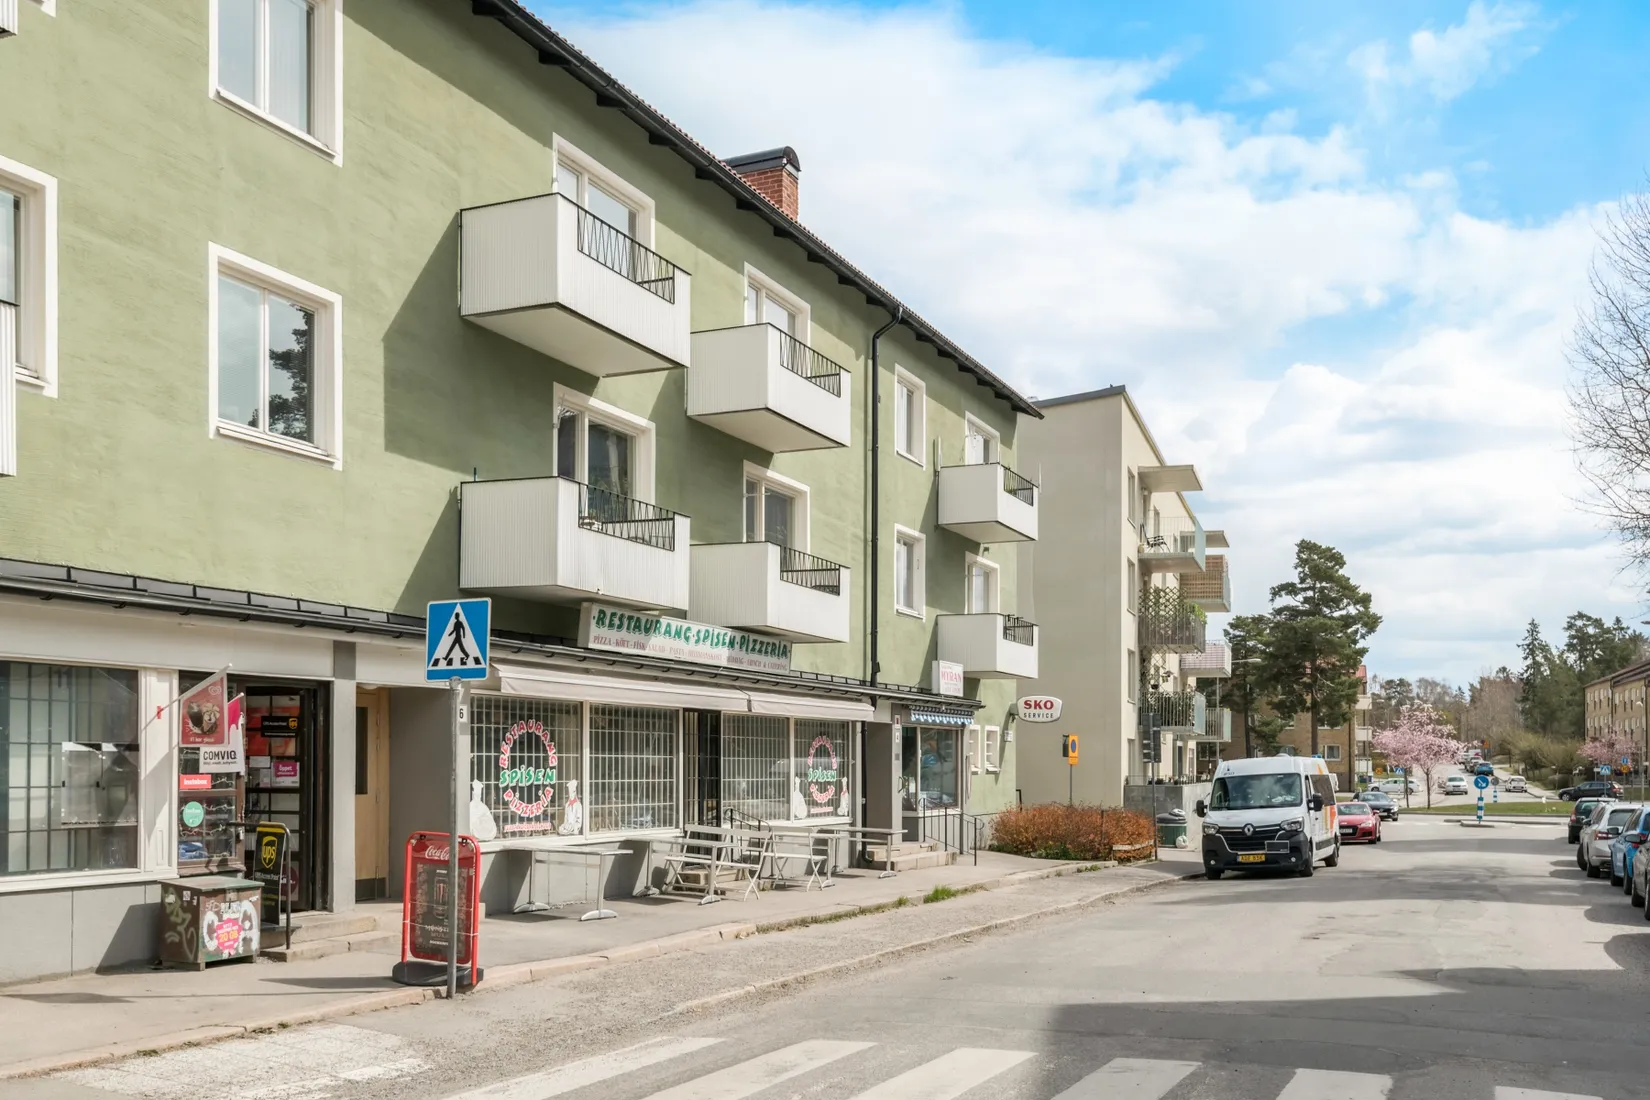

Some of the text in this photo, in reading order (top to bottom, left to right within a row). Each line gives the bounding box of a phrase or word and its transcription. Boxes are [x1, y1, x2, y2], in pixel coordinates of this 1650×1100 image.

[595, 609, 691, 645] RESTAURANG
[1023, 699, 1054, 710] SKO
[459, 708, 464, 719] 6
[498, 719, 558, 769] RESTAURANG
[203, 750, 237, 761] COMVIQ
[262, 845, 276, 864] ups
